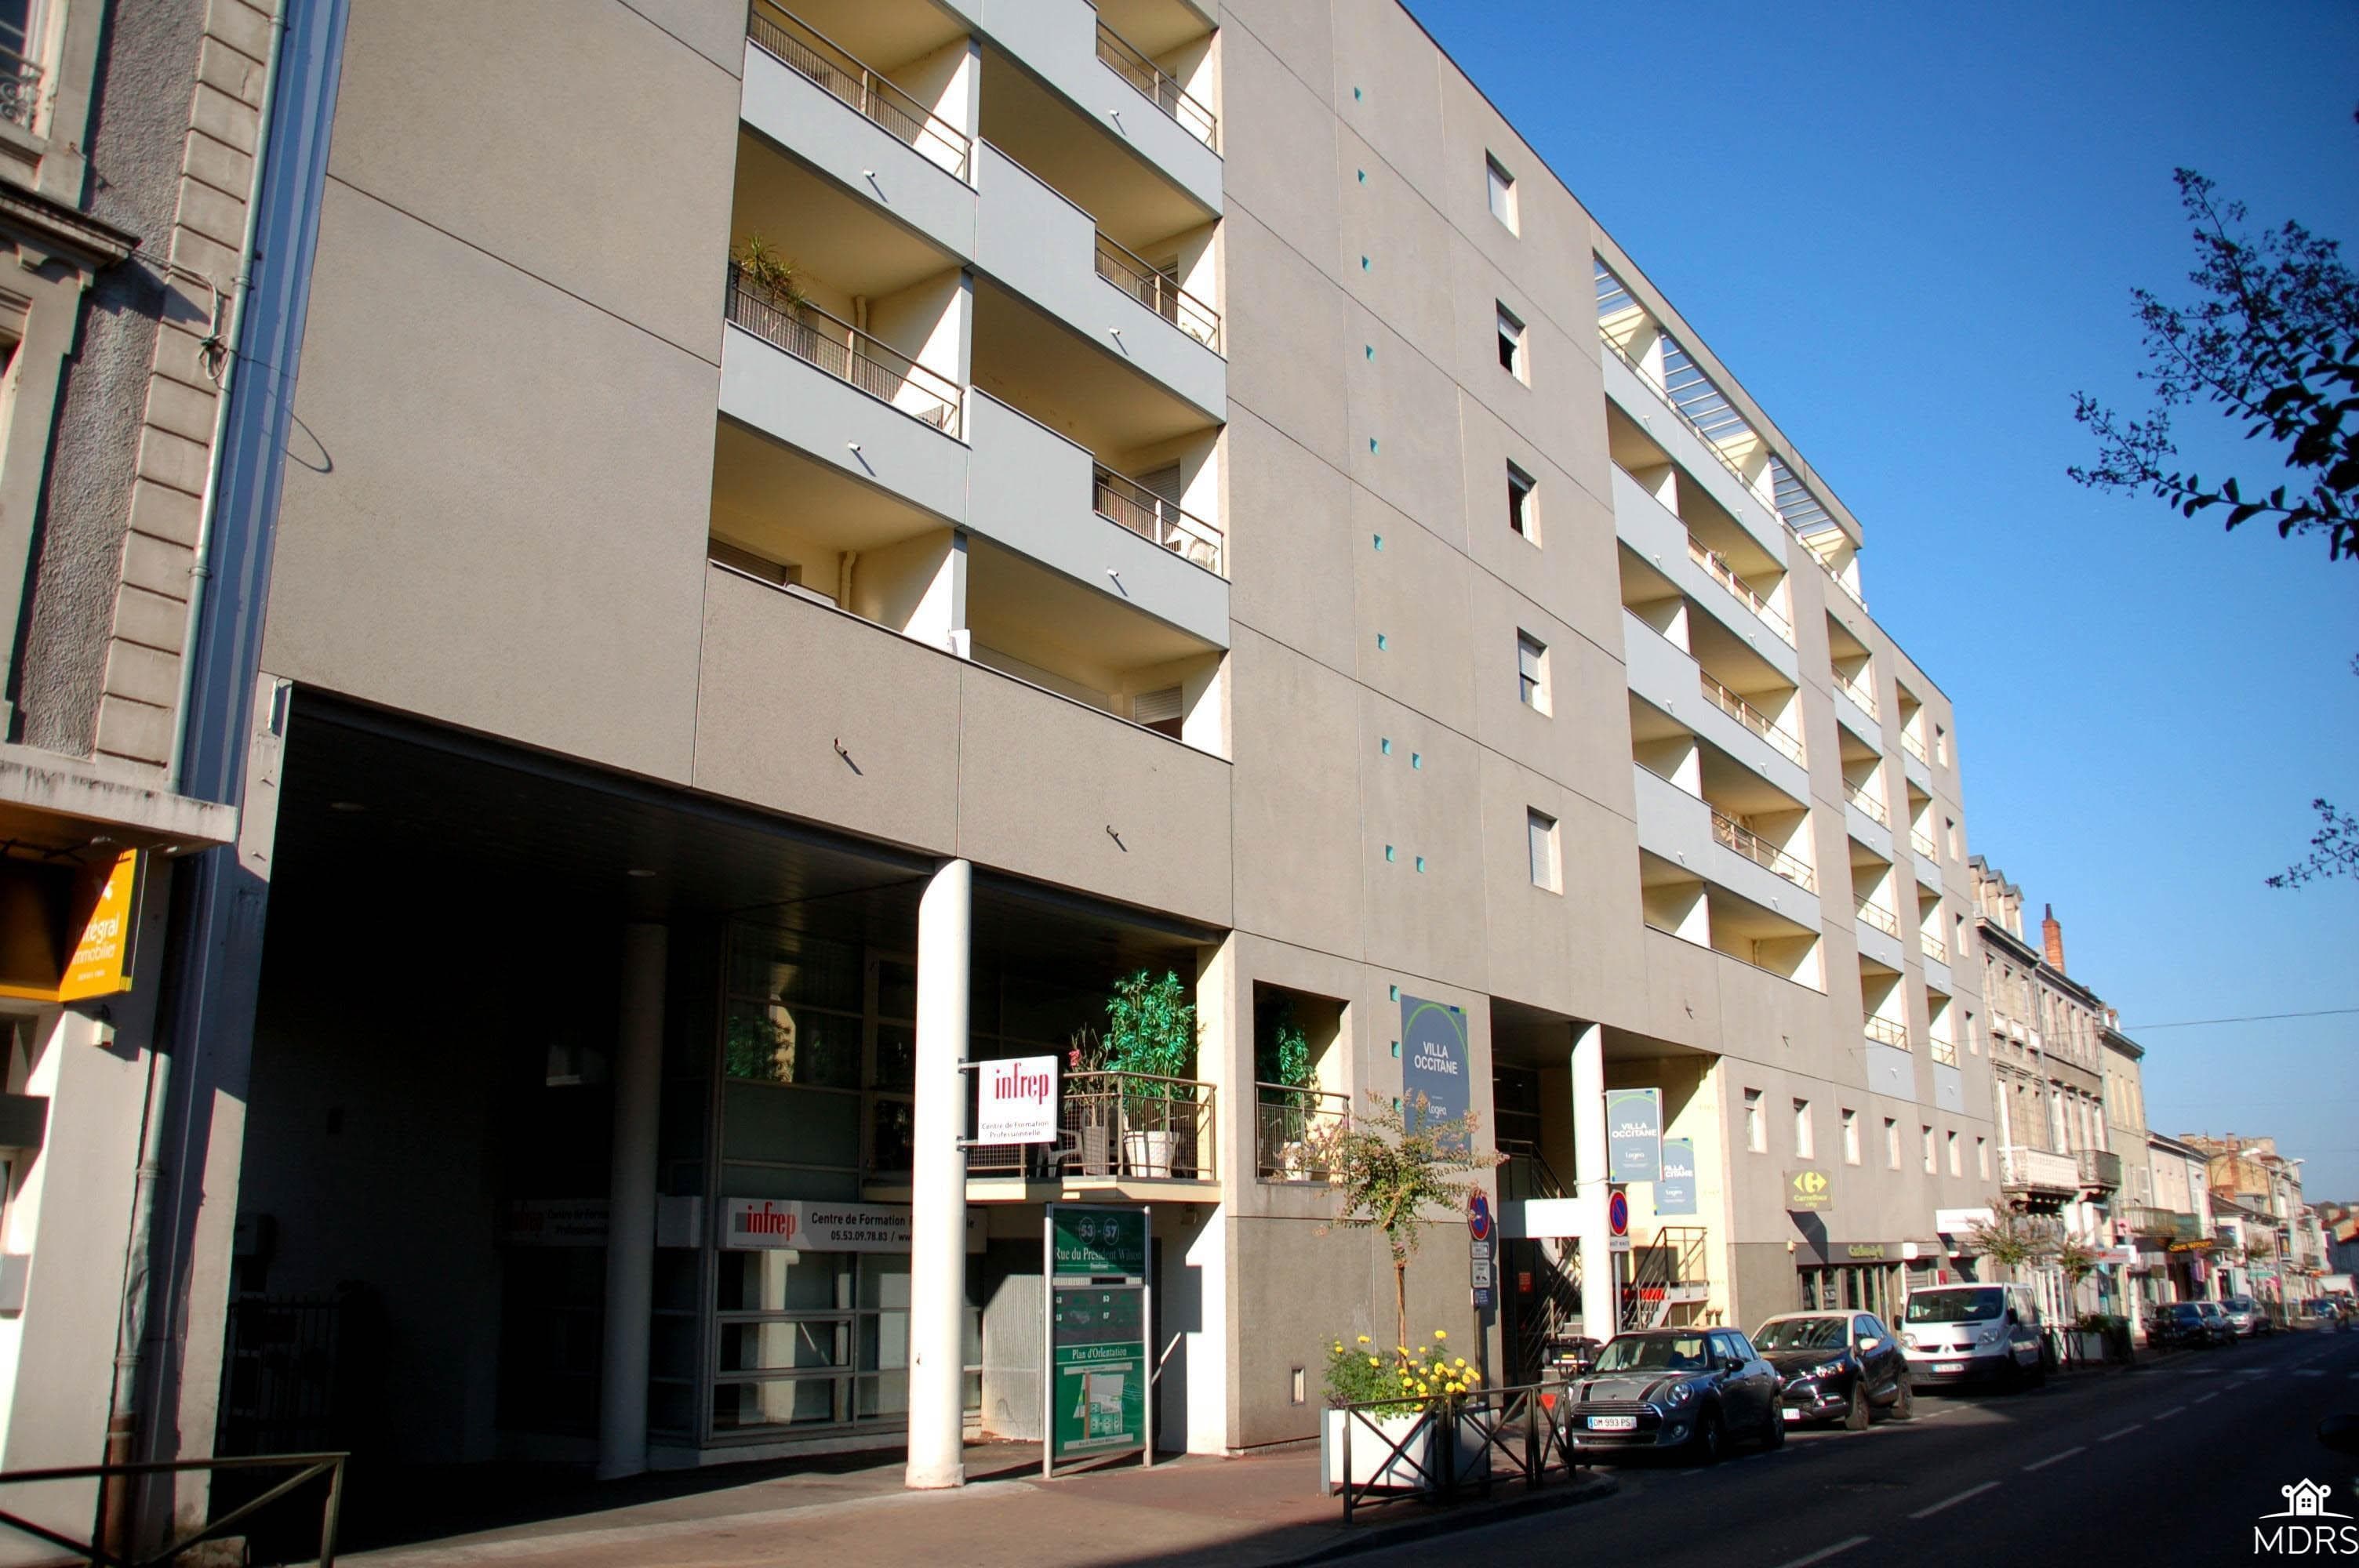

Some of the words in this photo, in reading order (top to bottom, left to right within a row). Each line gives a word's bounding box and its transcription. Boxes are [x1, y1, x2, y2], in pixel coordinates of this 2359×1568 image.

[1423, 1041, 1449, 1058] VILLA
[1414, 1054, 1458, 1075] OCCITANE
[995, 1062, 1049, 1105] infrep
[990, 1129, 1041, 1138] Professionnelle
[1612, 1129, 1658, 1138] OCCITANE
[747, 1200, 797, 1241] infrep
[811, 1212, 843, 1225] Centre
[845, 1212, 857, 1225] de
[859, 1213, 906, 1226] Formation
[831, 1230, 888, 1242] 05.53.09.78.83
[1081, 1225, 1093, 1238] 53
[1104, 1225, 1118, 1238] 57
[1055, 1247, 1070, 1261] Rue
[1071, 1247, 1081, 1261] du
[1083, 1247, 1117, 1261] Président
[1118, 1247, 1142, 1261] Wilson
[1072, 1348, 1086, 1360] Plan
[1087, 1347, 1127, 1359] d'Orientation
